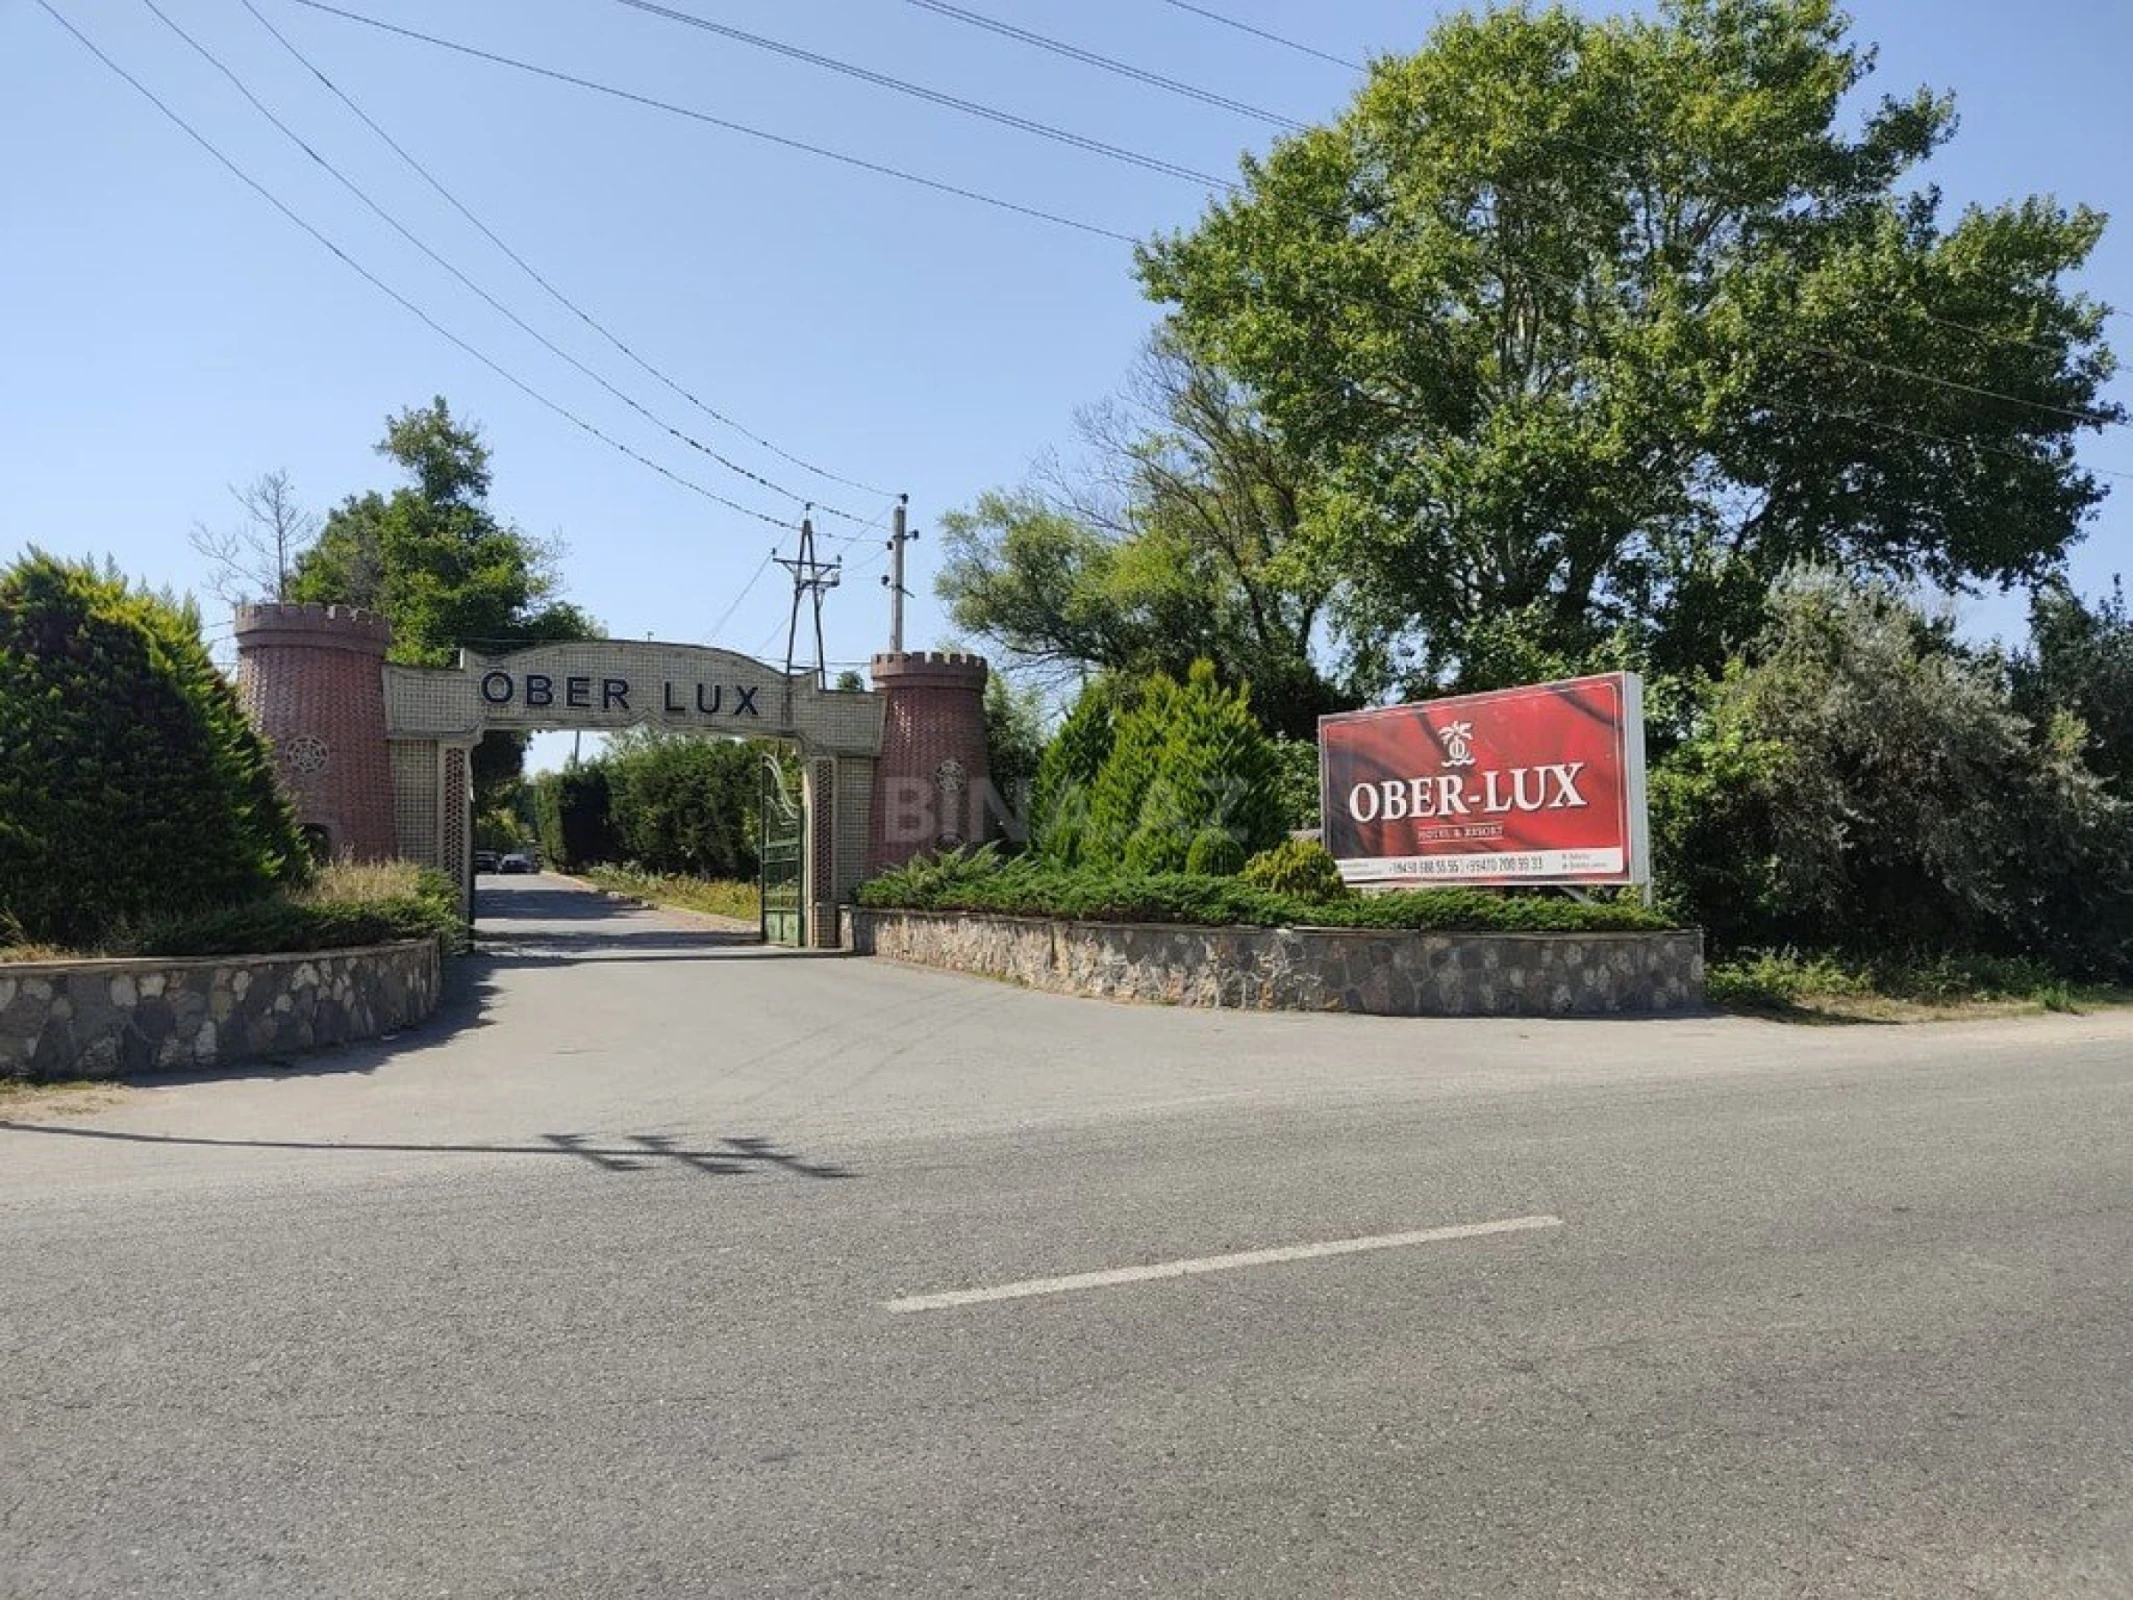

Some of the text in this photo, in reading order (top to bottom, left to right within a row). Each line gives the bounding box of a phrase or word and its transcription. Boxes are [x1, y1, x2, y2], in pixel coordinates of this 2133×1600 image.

[481, 671, 759, 716] OBER LUX
[1349, 762, 1588, 823] OBER-LUX
